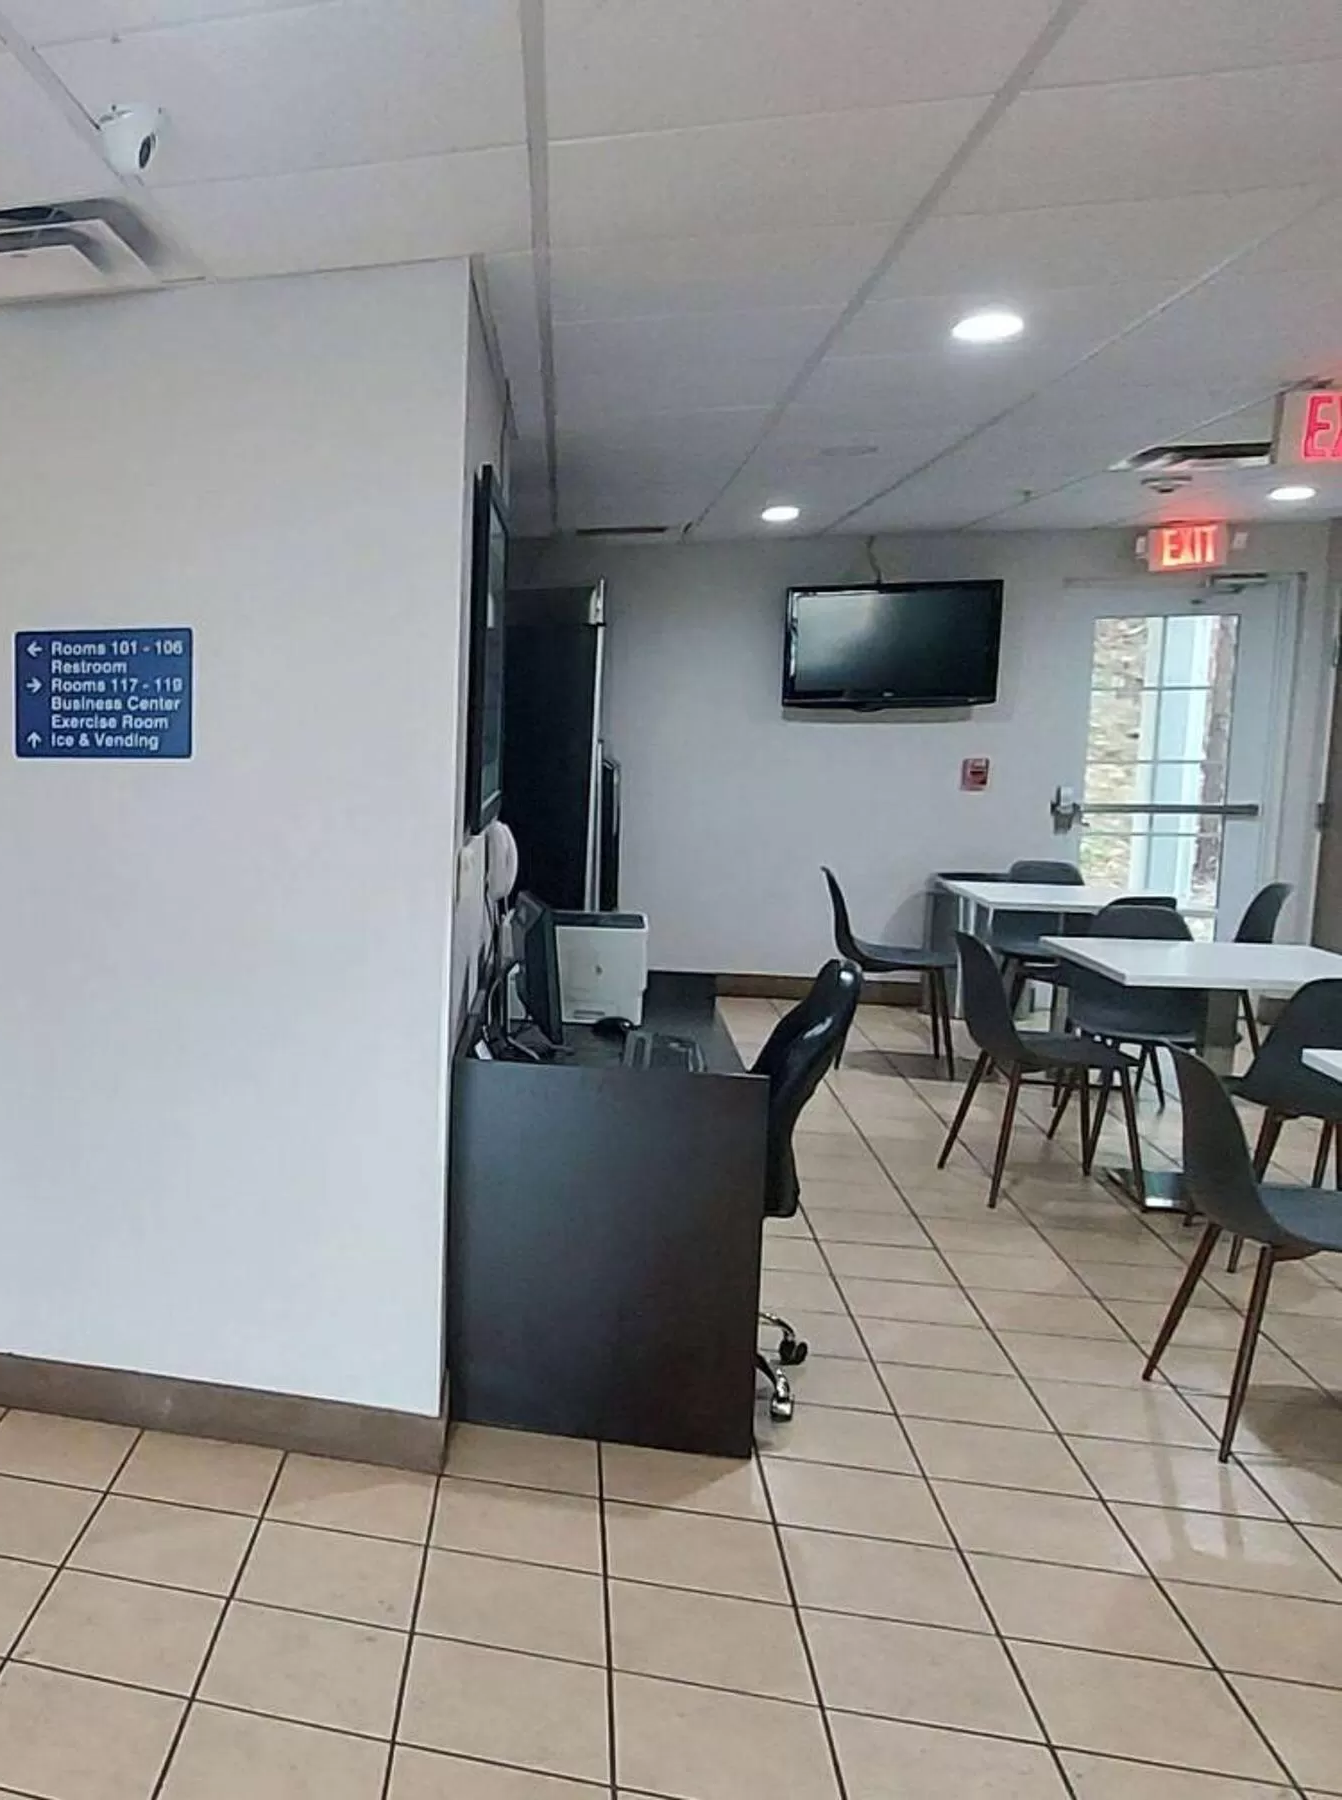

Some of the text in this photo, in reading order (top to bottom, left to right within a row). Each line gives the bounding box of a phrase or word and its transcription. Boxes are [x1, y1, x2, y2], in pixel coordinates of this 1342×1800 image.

[1161, 526, 1219, 567] EXIT
[51, 641, 106, 656] Rooms
[112, 640, 137, 656] 101
[155, 640, 184, 656] 106
[51, 659, 128, 675] Restroom
[51, 677, 106, 693] Rooms
[111, 677, 138, 693] 117
[154, 677, 183, 693] 119
[51, 695, 181, 711] Business Center
[51, 713, 169, 730] Exercise Room
[51, 732, 159, 751] Ice & Vending
